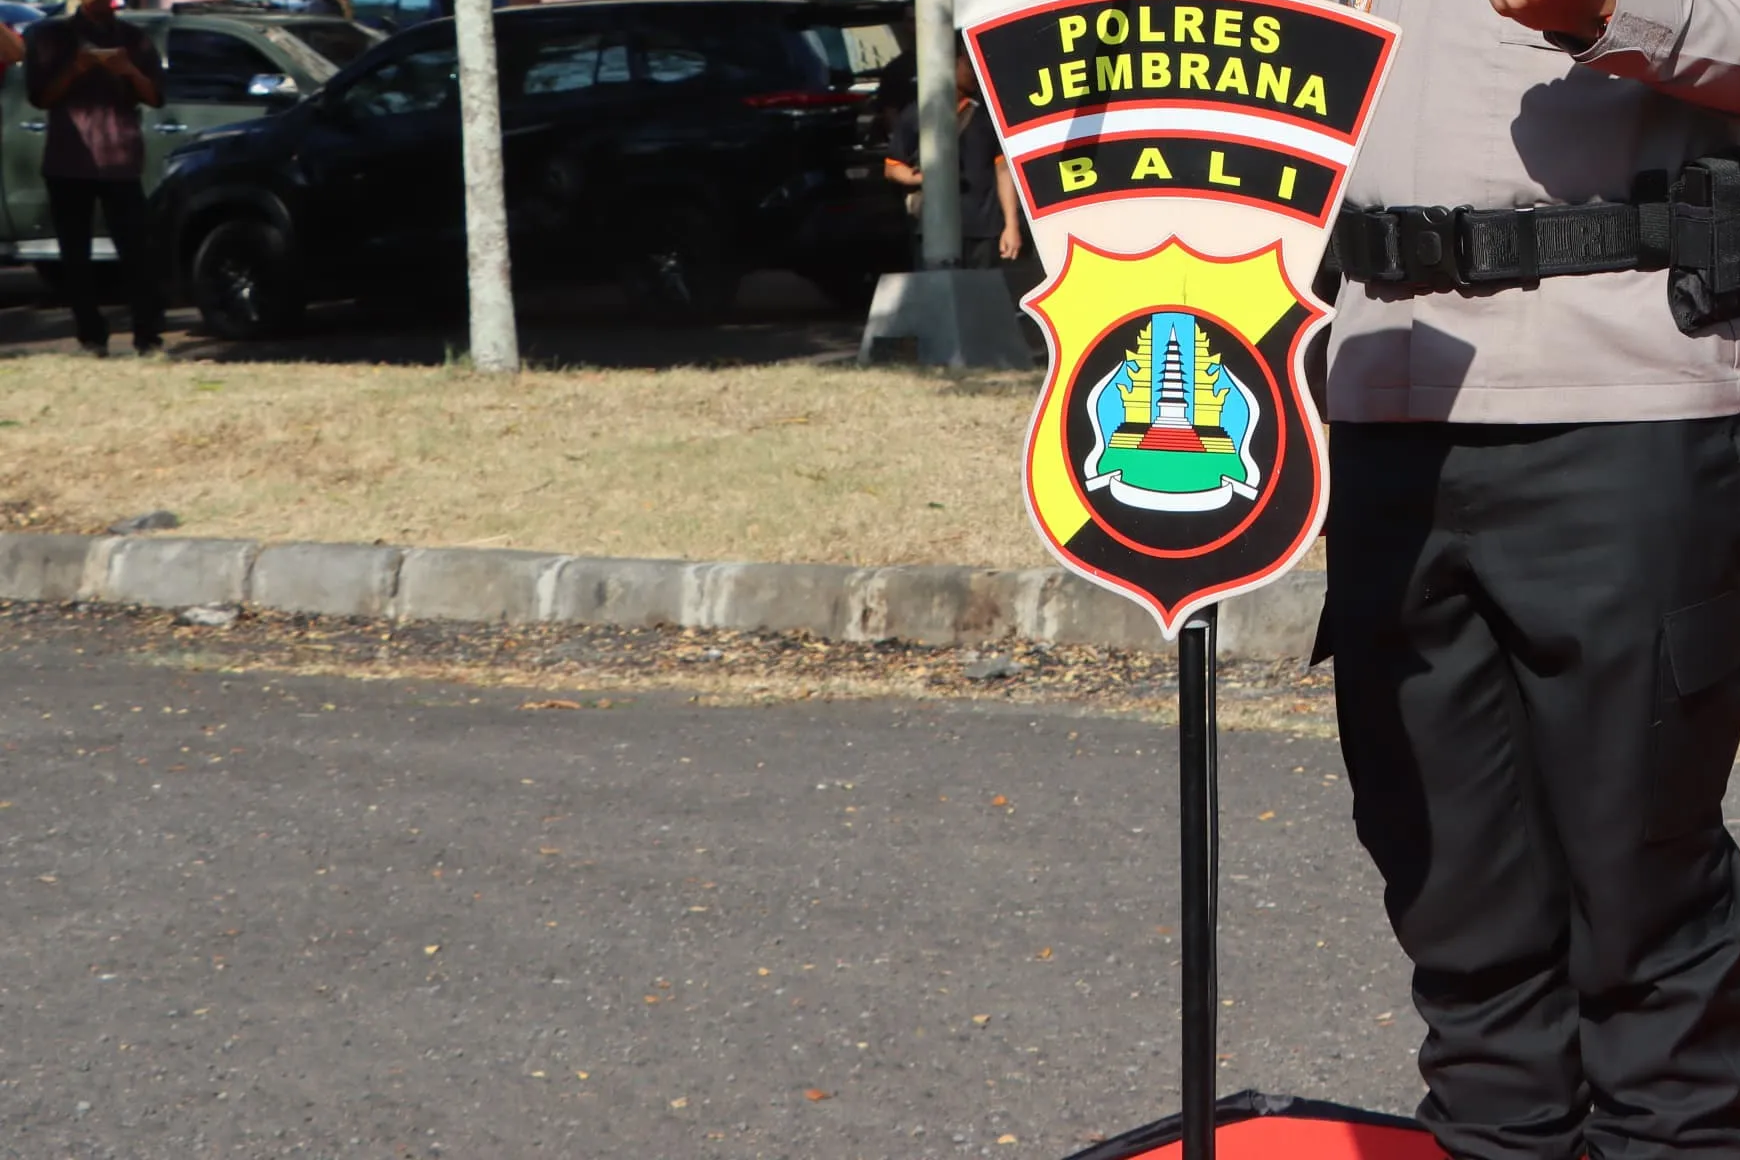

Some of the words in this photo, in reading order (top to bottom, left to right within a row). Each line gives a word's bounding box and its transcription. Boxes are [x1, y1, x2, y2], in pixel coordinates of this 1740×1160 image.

[1058, 5, 1281, 54] POLRES
[1028, 51, 1328, 116] JEMBRANA
[1058, 147, 1297, 201] BALI
